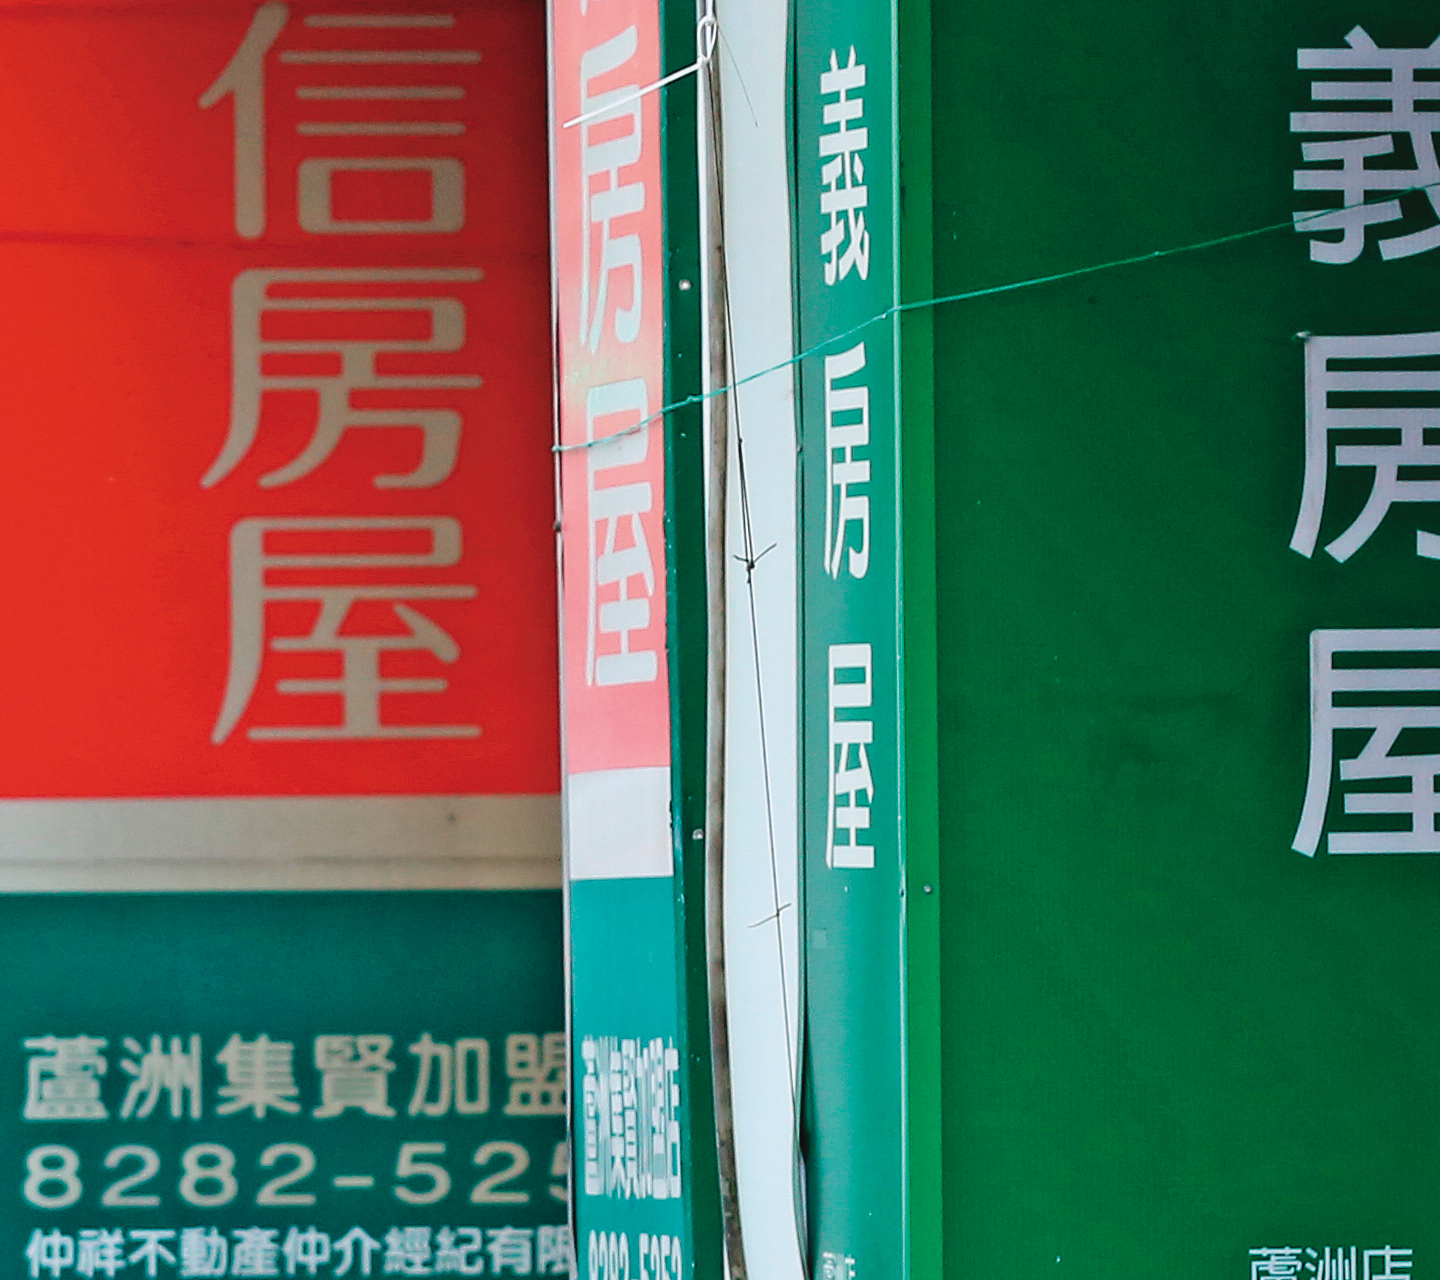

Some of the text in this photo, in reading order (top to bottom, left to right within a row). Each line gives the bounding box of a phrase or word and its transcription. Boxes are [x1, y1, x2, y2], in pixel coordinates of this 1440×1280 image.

[581, 1034, 683, 1201] 蘆洲集賢加盟店
